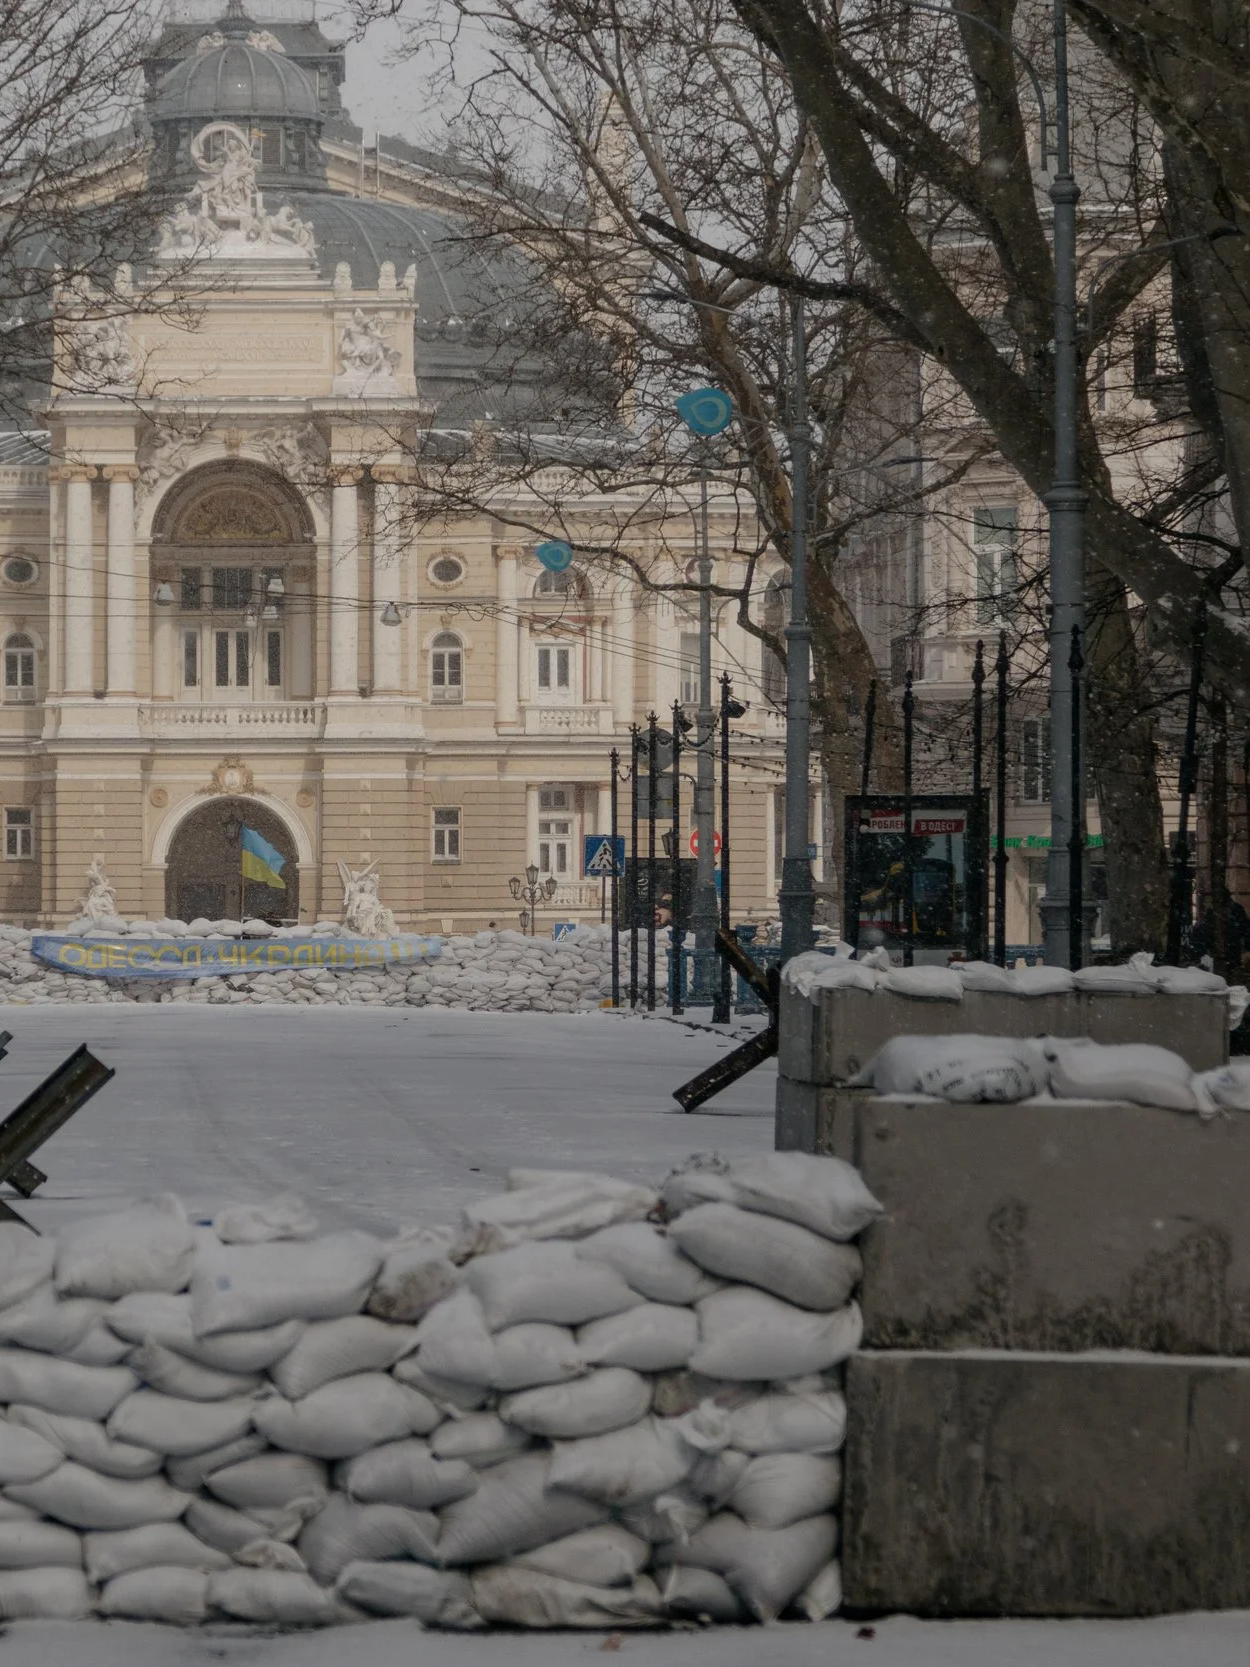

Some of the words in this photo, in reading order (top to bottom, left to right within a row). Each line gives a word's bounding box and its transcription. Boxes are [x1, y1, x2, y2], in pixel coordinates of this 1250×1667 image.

[869, 820, 906, 830] РОБЛЕН
[920, 821, 926, 831] В
[928, 821, 955, 832] ОДЕСІ
